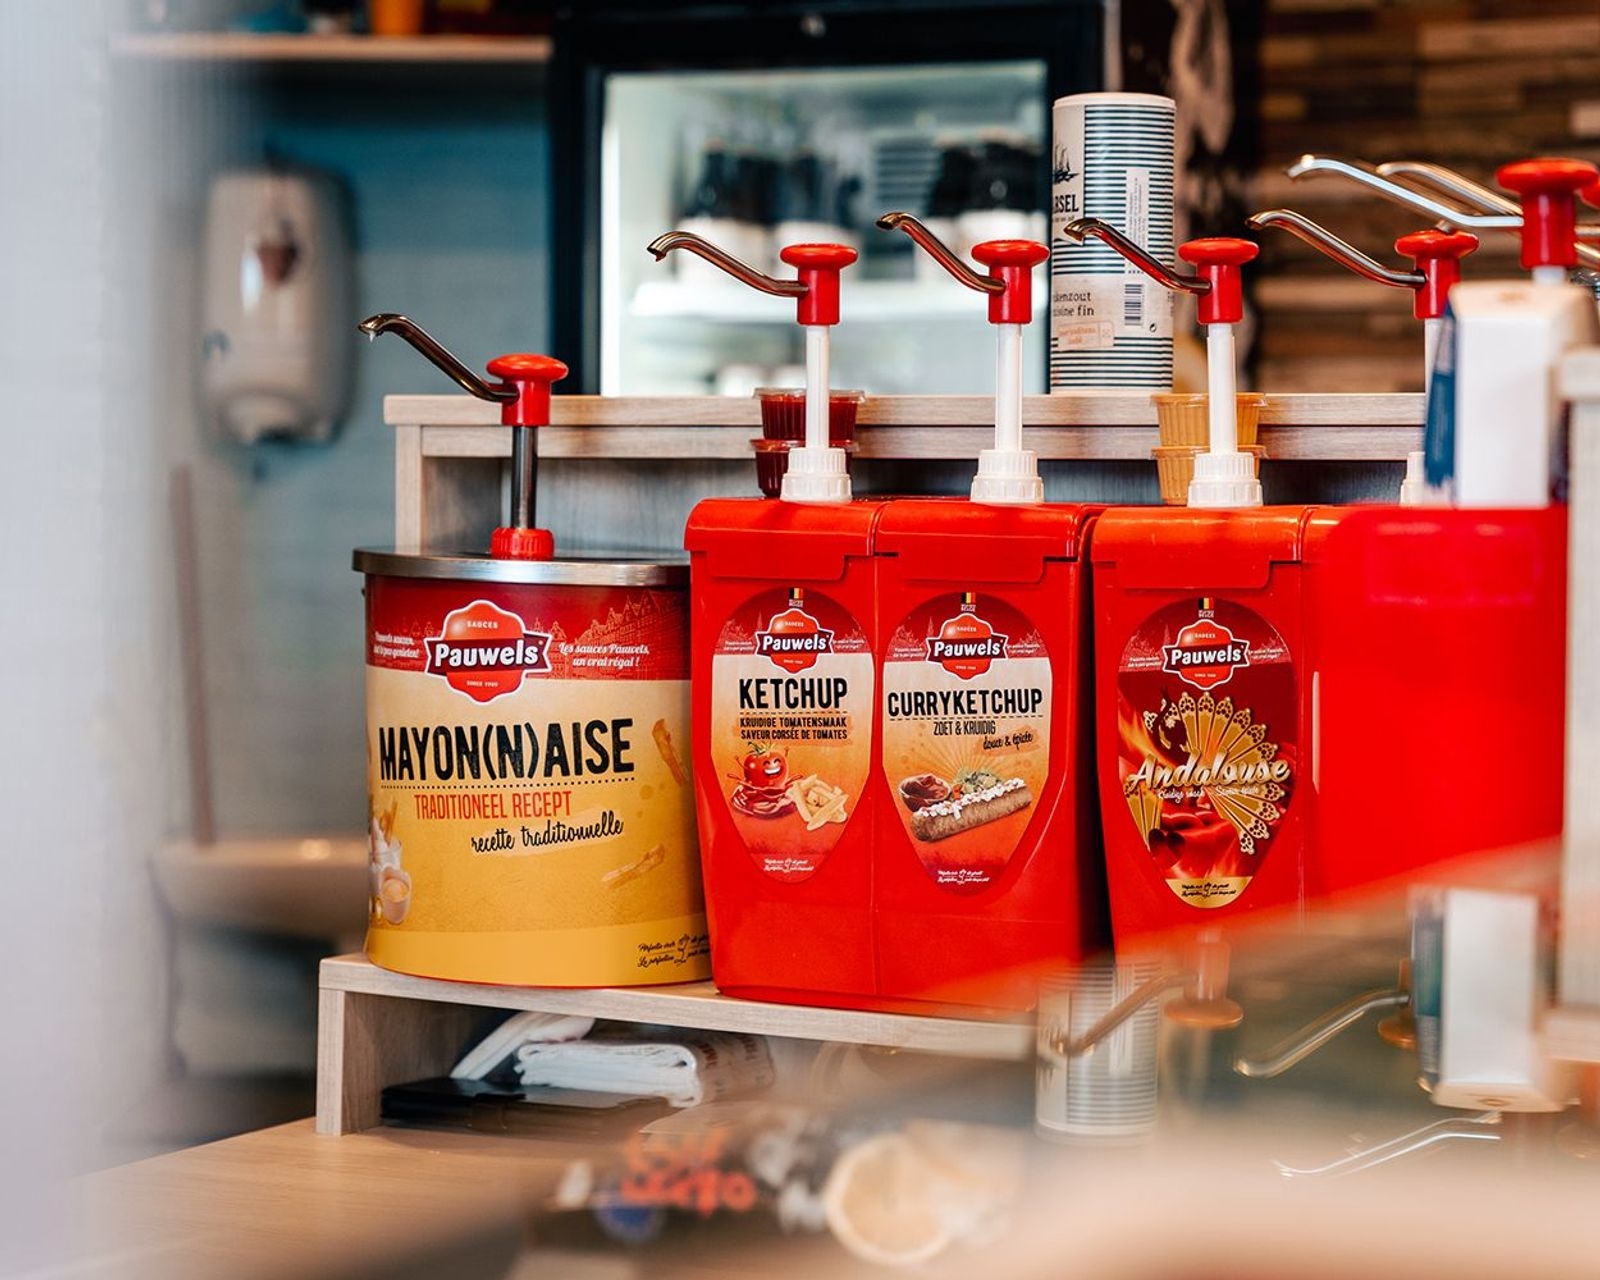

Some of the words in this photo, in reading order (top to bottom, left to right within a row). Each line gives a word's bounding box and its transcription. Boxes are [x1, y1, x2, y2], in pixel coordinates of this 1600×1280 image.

[1077, 305, 1094, 316] fin
[466, 620, 498, 629] SAUCES
[559, 642, 574, 656] Les
[575, 644, 607, 654] sauces
[762, 634, 827, 651] Pauwels
[934, 638, 1000, 657] Pauwels
[434, 639, 538, 668] Pauwels
[1171, 645, 1242, 666] Pauwels
[739, 678, 848, 710] KETCHUP
[887, 688, 1043, 717] CURRYKETCHUP
[740, 717, 777, 728] KRUIDIGE
[779, 717, 847, 728] TOMATENSMAAK
[934, 721, 953, 736] ZOET
[955, 721, 962, 736] &
[963, 720, 996, 735] KRUIDIG
[741, 729, 771, 740] SAVEUR
[771, 727, 799, 740] CORSÉE
[801, 729, 811, 740] DE
[812, 729, 848, 740] TOMATES
[1004, 735, 1011, 747] &
[379, 718, 635, 781] MAYON(N)AISE
[1127, 750, 1291, 790] Andalouse
[414, 792, 508, 820] TRADITIONEEL
[512, 790, 572, 819] RECEPT
[471, 828, 516, 853] recette
[521, 810, 625, 848] traditionnelle
